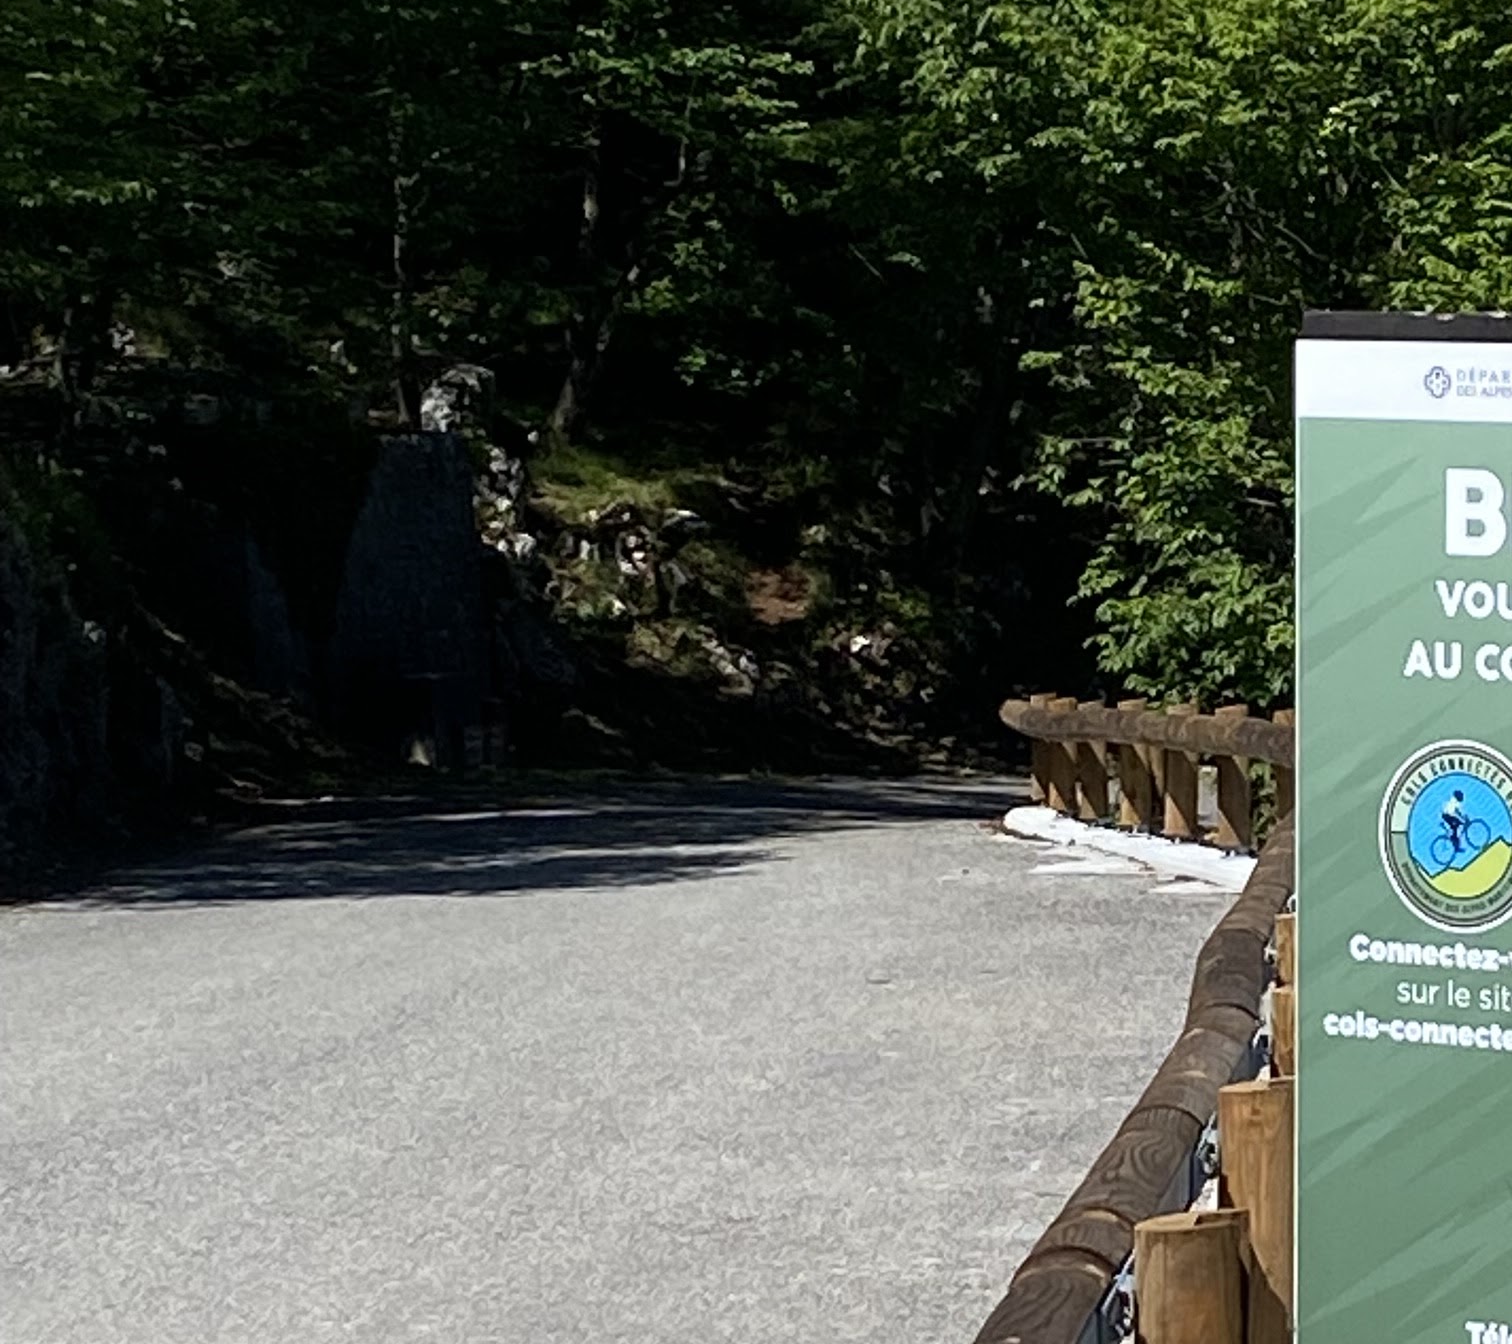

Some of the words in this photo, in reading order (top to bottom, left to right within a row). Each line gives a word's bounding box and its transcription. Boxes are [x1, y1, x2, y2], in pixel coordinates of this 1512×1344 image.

[1402, 638, 1463, 680] AU
[1396, 981, 1442, 1006] sur
[1446, 978, 1472, 1009] le
